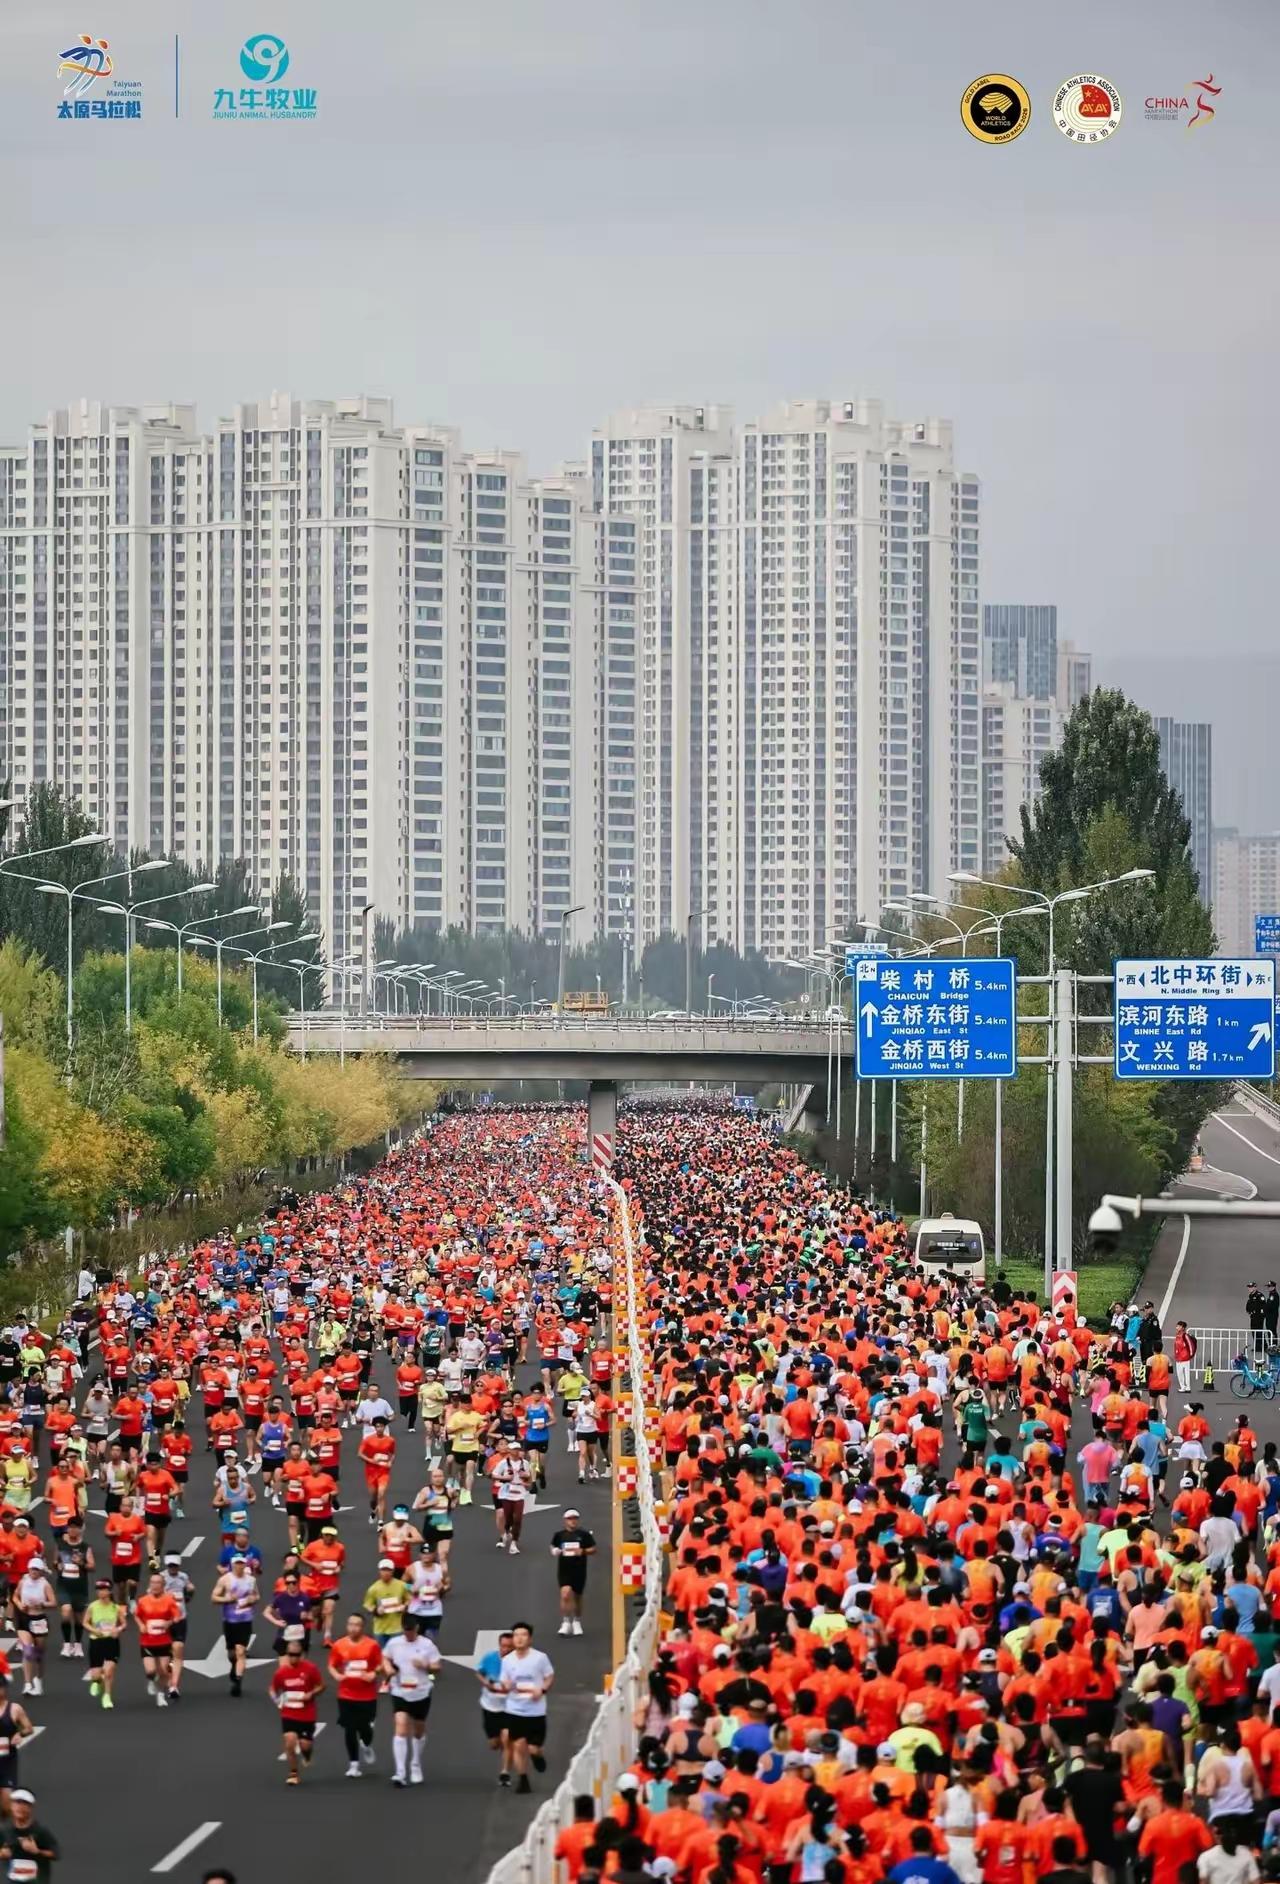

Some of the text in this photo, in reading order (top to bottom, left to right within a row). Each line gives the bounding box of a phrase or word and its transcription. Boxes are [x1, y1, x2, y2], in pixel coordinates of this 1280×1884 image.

[860, 963, 869, 973] 北
[1126, 974, 1136, 985] 西
[1151, 965, 1241, 985] 北中环街
[1255, 974, 1266, 985] 东
[880, 967, 1007, 991] 柴村桥 5.4km
[941, 992, 969, 1001] Bridge
[880, 1004, 1007, 1025] 金桥东街 5.4km
[1119, 1005, 1208, 1026] 滨河东路
[880, 1039, 1008, 1060] 金桥西街 5.4km
[1120, 1040, 1208, 1062] 文兴路
[889, 1062, 923, 1070] JINQIAO
[1189, 1063, 1202, 1071] Rd
